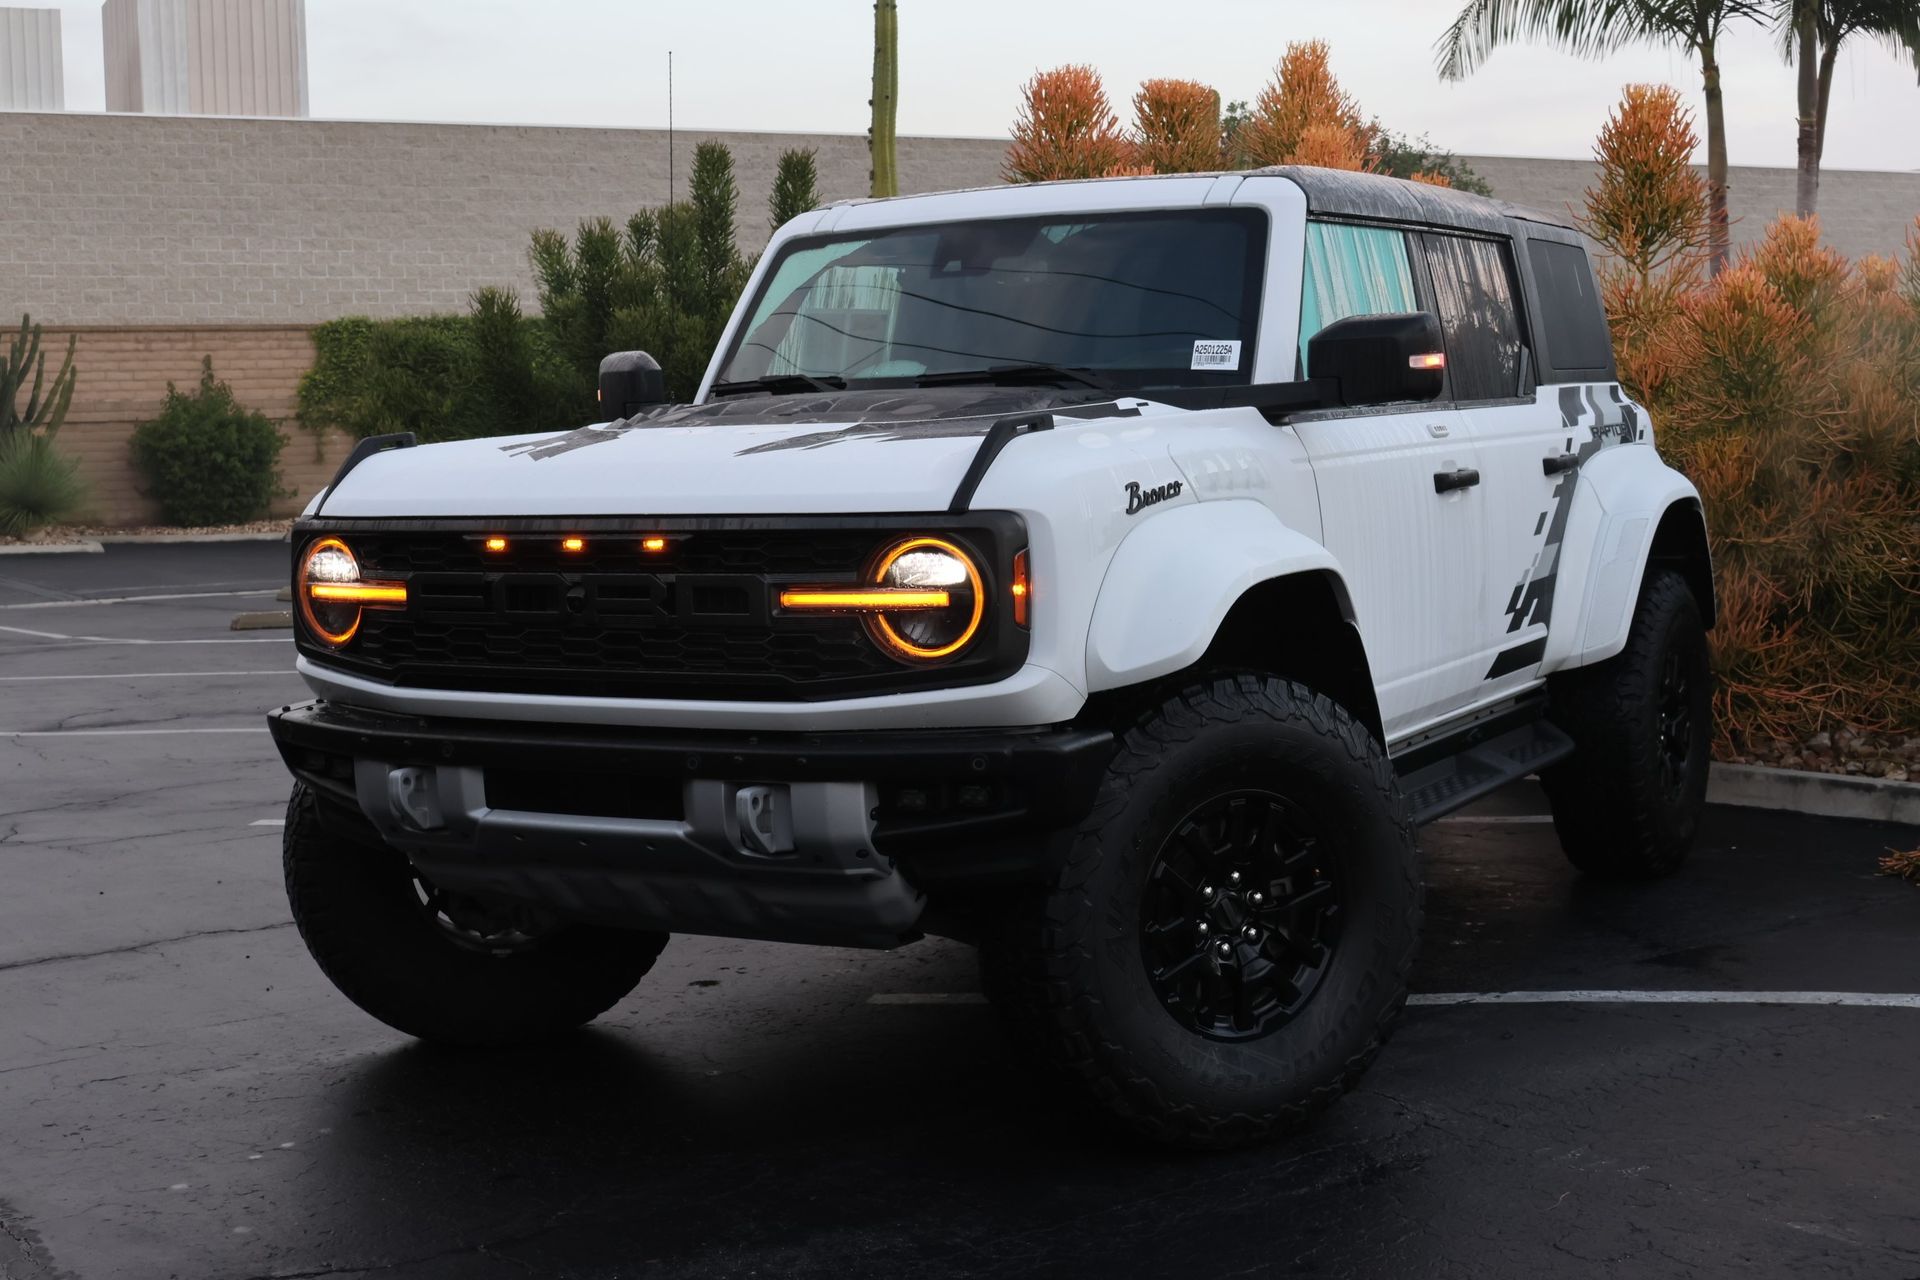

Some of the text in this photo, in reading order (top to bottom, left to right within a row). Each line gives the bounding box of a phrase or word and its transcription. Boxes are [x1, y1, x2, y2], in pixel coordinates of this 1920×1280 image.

[1590, 423, 1628, 441] RAPTOR
[1125, 480, 1183, 515] Bronco
[410, 572, 767, 627] FORD
